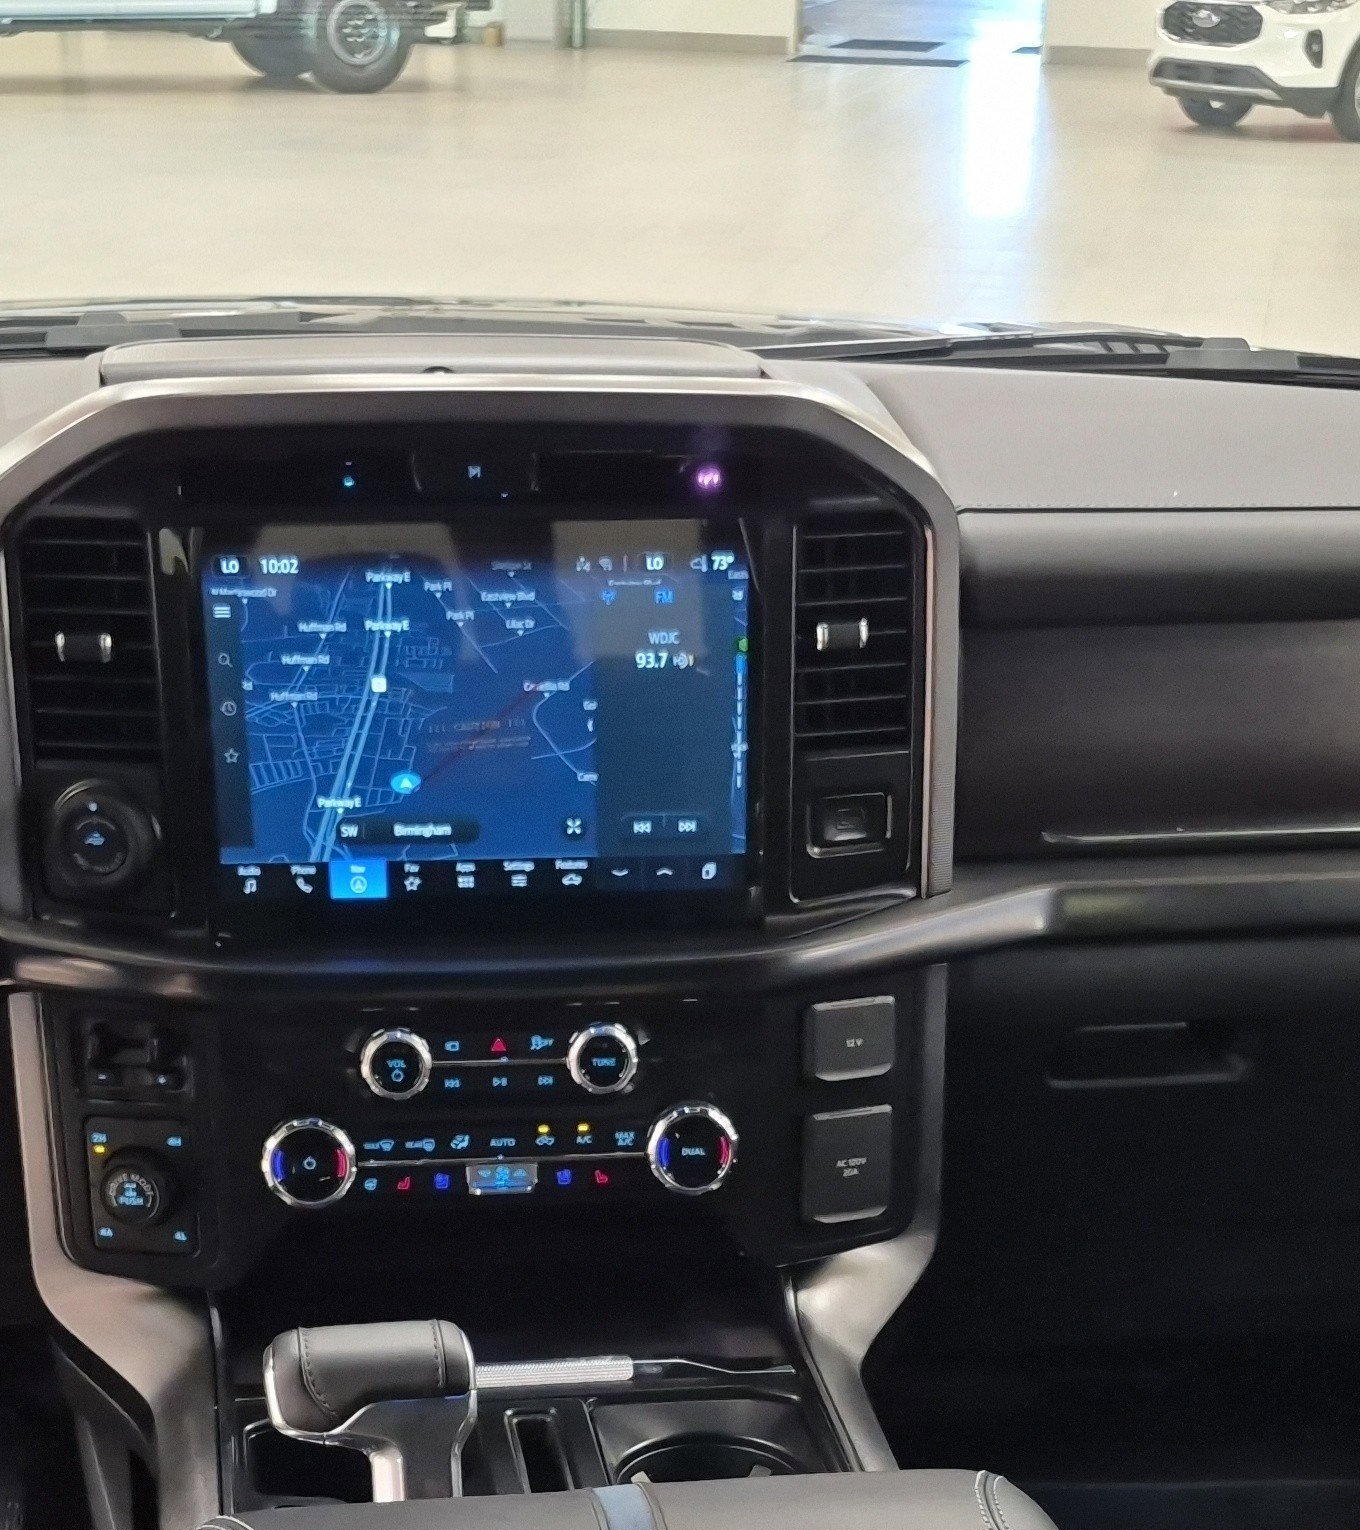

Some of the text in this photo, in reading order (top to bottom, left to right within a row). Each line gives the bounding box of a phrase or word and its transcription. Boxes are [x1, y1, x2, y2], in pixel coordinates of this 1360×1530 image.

[219, 557, 240, 574] LO
[259, 557, 300, 574] 10:02
[646, 557, 665, 571] LO
[635, 651, 669, 669] 93.7
[340, 824, 359, 838] SW
[394, 823, 452, 837] Birmingham
[386, 1059, 406, 1069] VOL
[490, 1137, 516, 1147] AUTO
[681, 1148, 706, 1156] DUAL
